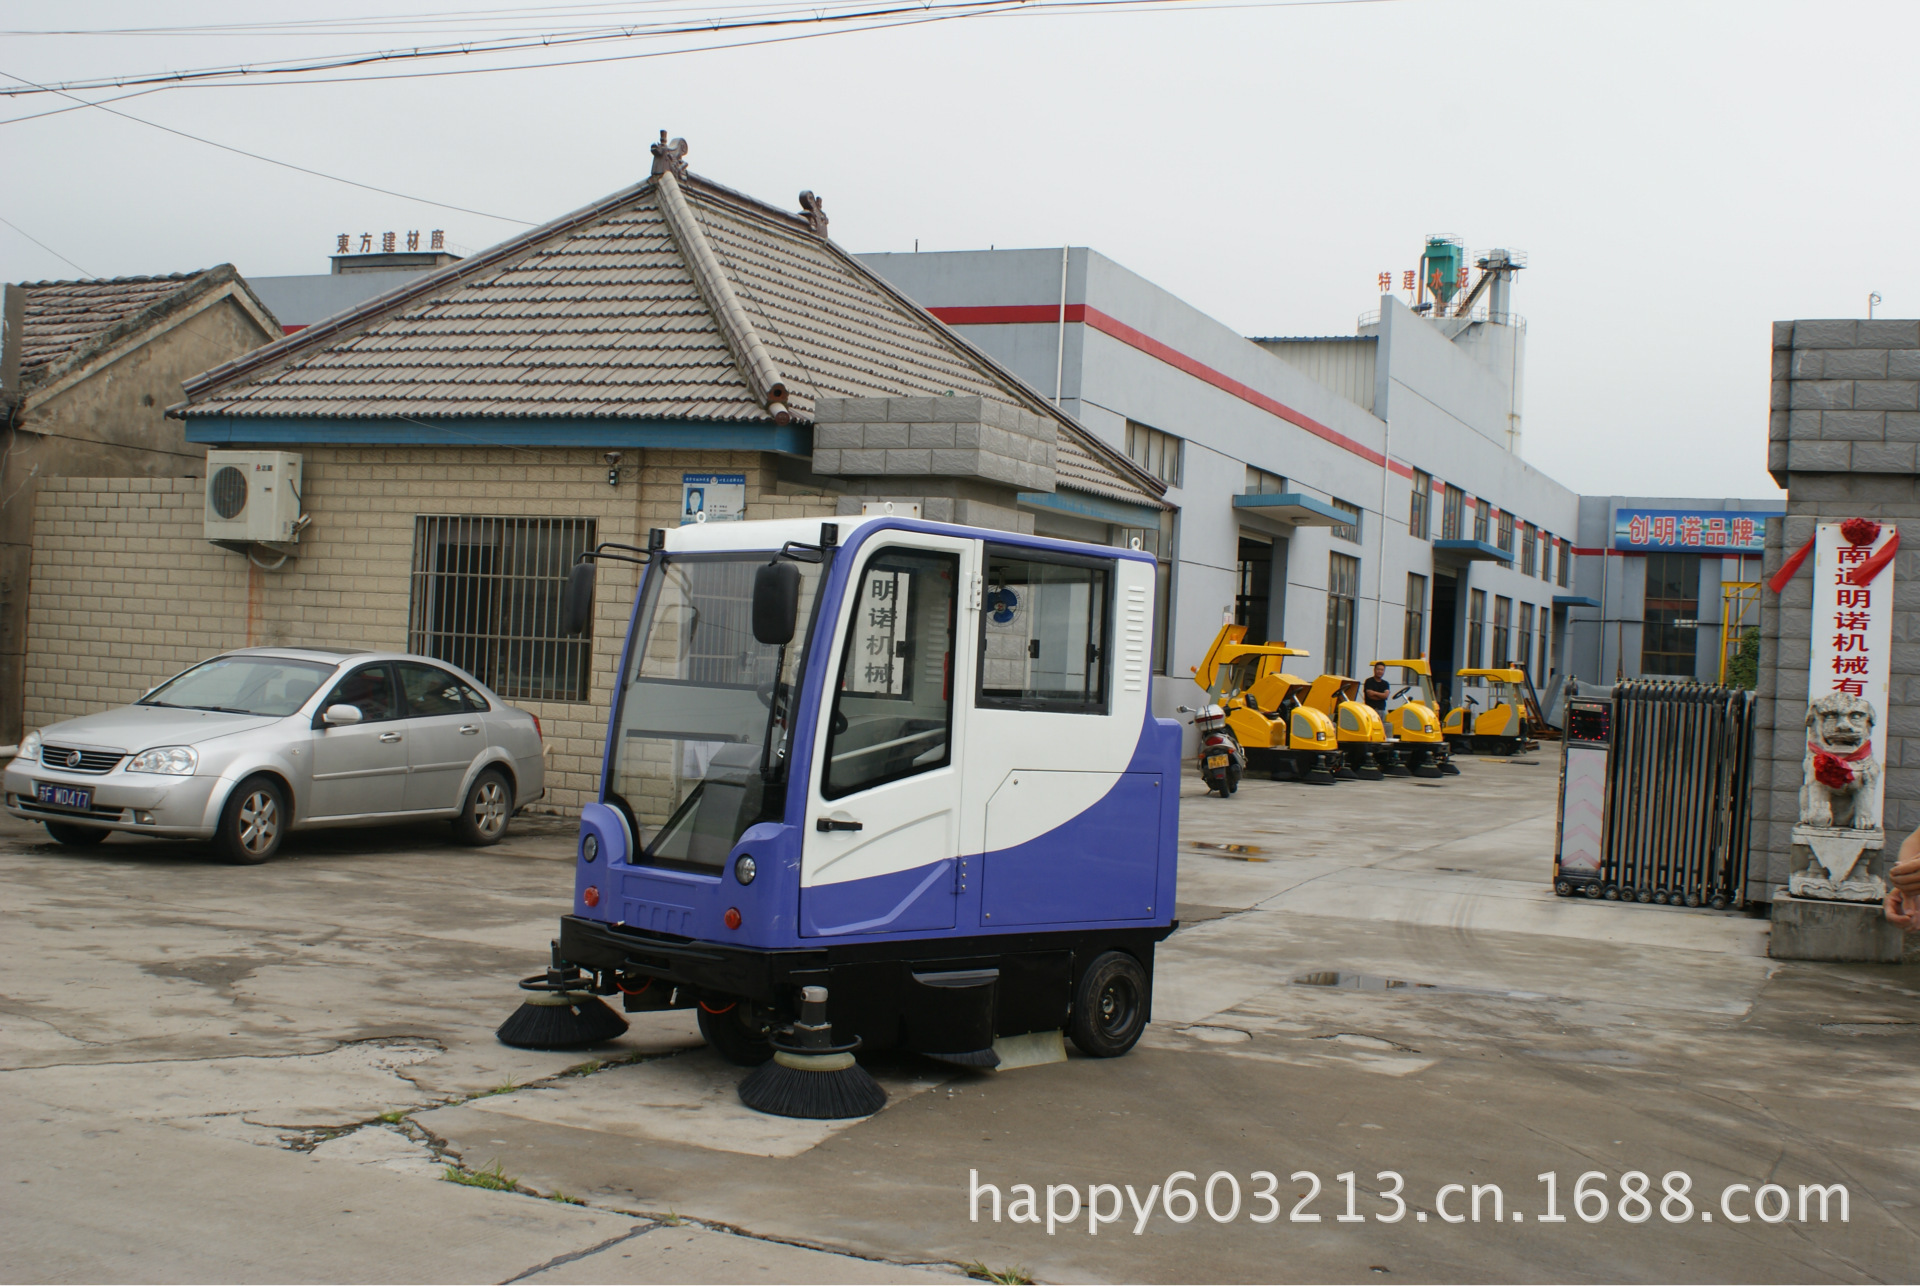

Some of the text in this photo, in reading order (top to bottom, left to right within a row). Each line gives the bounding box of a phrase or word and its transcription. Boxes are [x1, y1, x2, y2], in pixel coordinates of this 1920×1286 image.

[1378, 267, 1469, 292] 特建水泥
[1628, 514, 1755, 547] 创明诺品牌
[864, 579, 899, 685] 明诺机械
